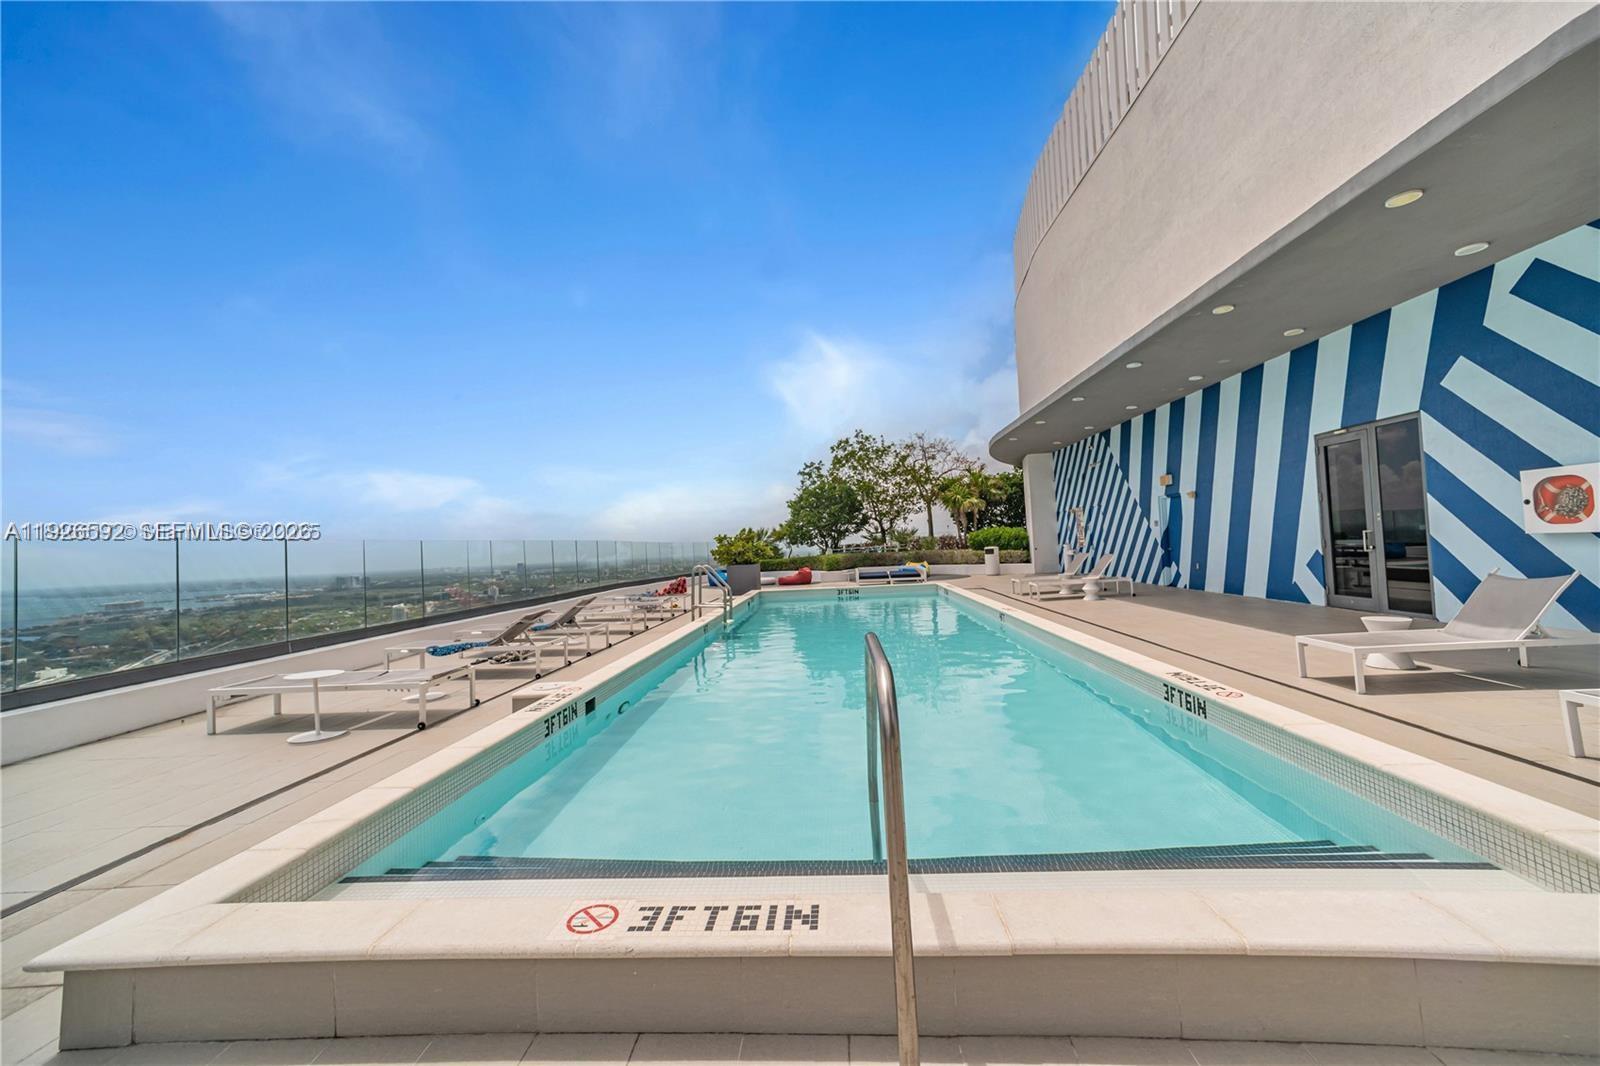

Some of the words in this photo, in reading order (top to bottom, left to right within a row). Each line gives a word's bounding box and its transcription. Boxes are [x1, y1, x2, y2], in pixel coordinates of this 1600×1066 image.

[1163, 683, 1207, 719] 3FT6IN
[544, 702, 578, 738] 3FT6IN
[626, 904, 820, 932] 3FT6IN
